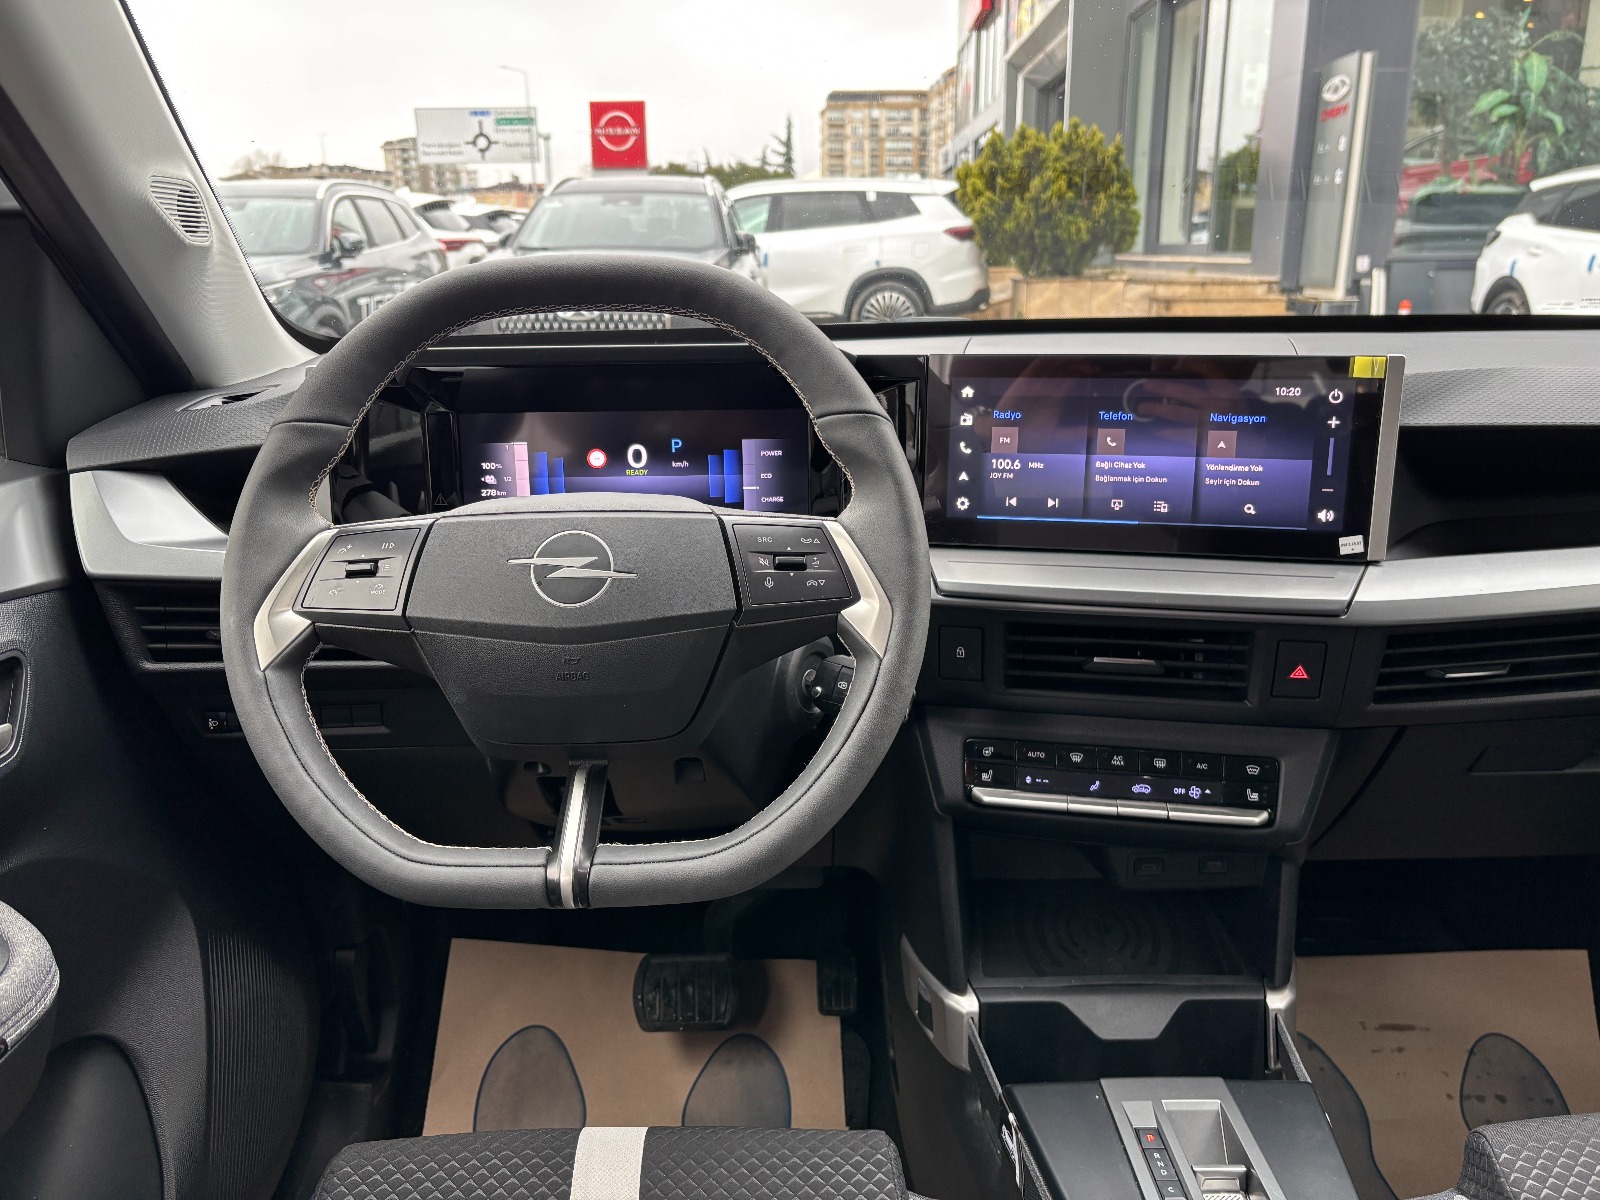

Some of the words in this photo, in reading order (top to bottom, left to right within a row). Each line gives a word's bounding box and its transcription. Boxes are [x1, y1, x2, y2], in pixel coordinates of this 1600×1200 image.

[594, 127, 641, 136] NISSAN
[1275, 387, 1302, 396] 10:20
[993, 410, 1022, 420] Radyo
[1098, 411, 1133, 421] Telefon
[1209, 412, 1267, 425] Navigasyon
[671, 438, 683, 452] P
[627, 443, 648, 468] 0
[671, 460, 689, 468] km/h
[991, 458, 1021, 470] 100.6
[1028, 461, 1044, 469] MHz
[1095, 460, 1113, 469] Bağlı
[1113, 461, 1132, 469] Cihaz
[1205, 463, 1249, 472] Yönlendirme
[1249, 464, 1263, 472] Yok
[1095, 474, 1131, 483] Bağlanmak
[1204, 477, 1222, 486] Seyir
[1237, 478, 1260, 486] Dokun
[480, 489, 497, 497] 278
[555, 671, 589, 681] AIRBAG
[1196, 762, 1208, 770] A/C
[1173, 787, 1186, 795] OFF
